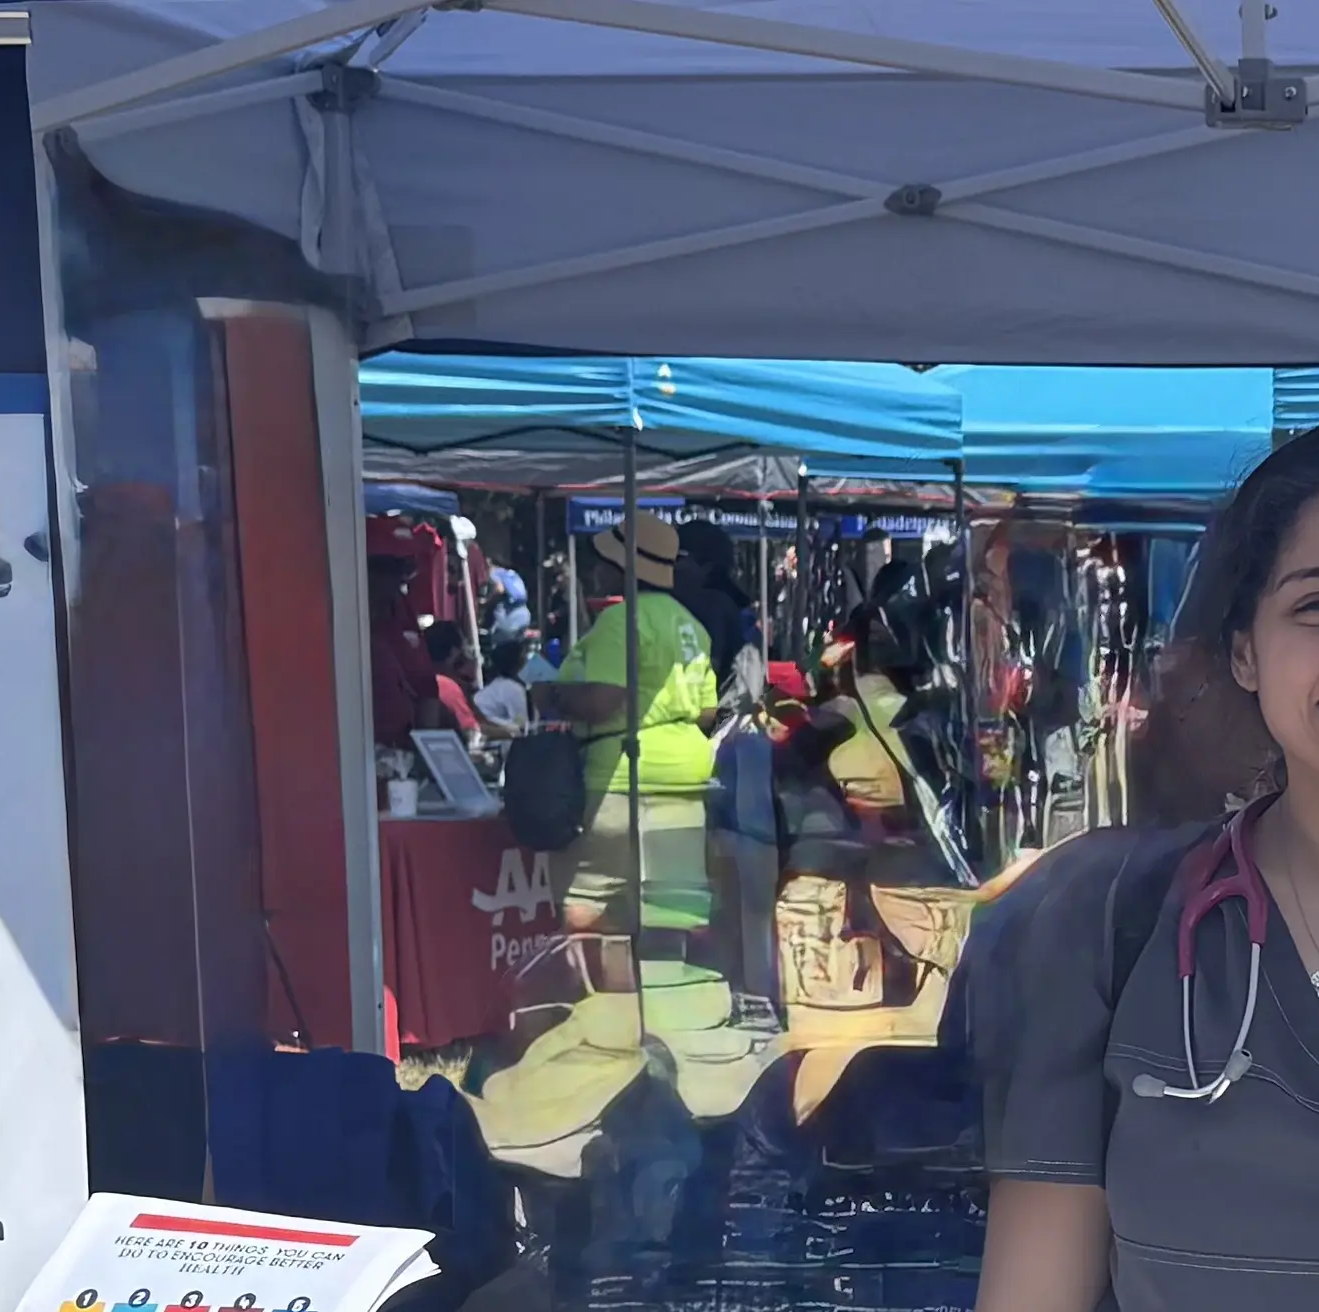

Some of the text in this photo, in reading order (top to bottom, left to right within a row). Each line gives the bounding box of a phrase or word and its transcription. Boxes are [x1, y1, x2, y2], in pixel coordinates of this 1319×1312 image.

[114, 1236, 345, 1261] HERE ARE 10 THINGS YOU CAN
[118, 1249, 324, 1270] DO TO ENCOURAGE BETTER
[178, 1262, 246, 1276] HEALTH
